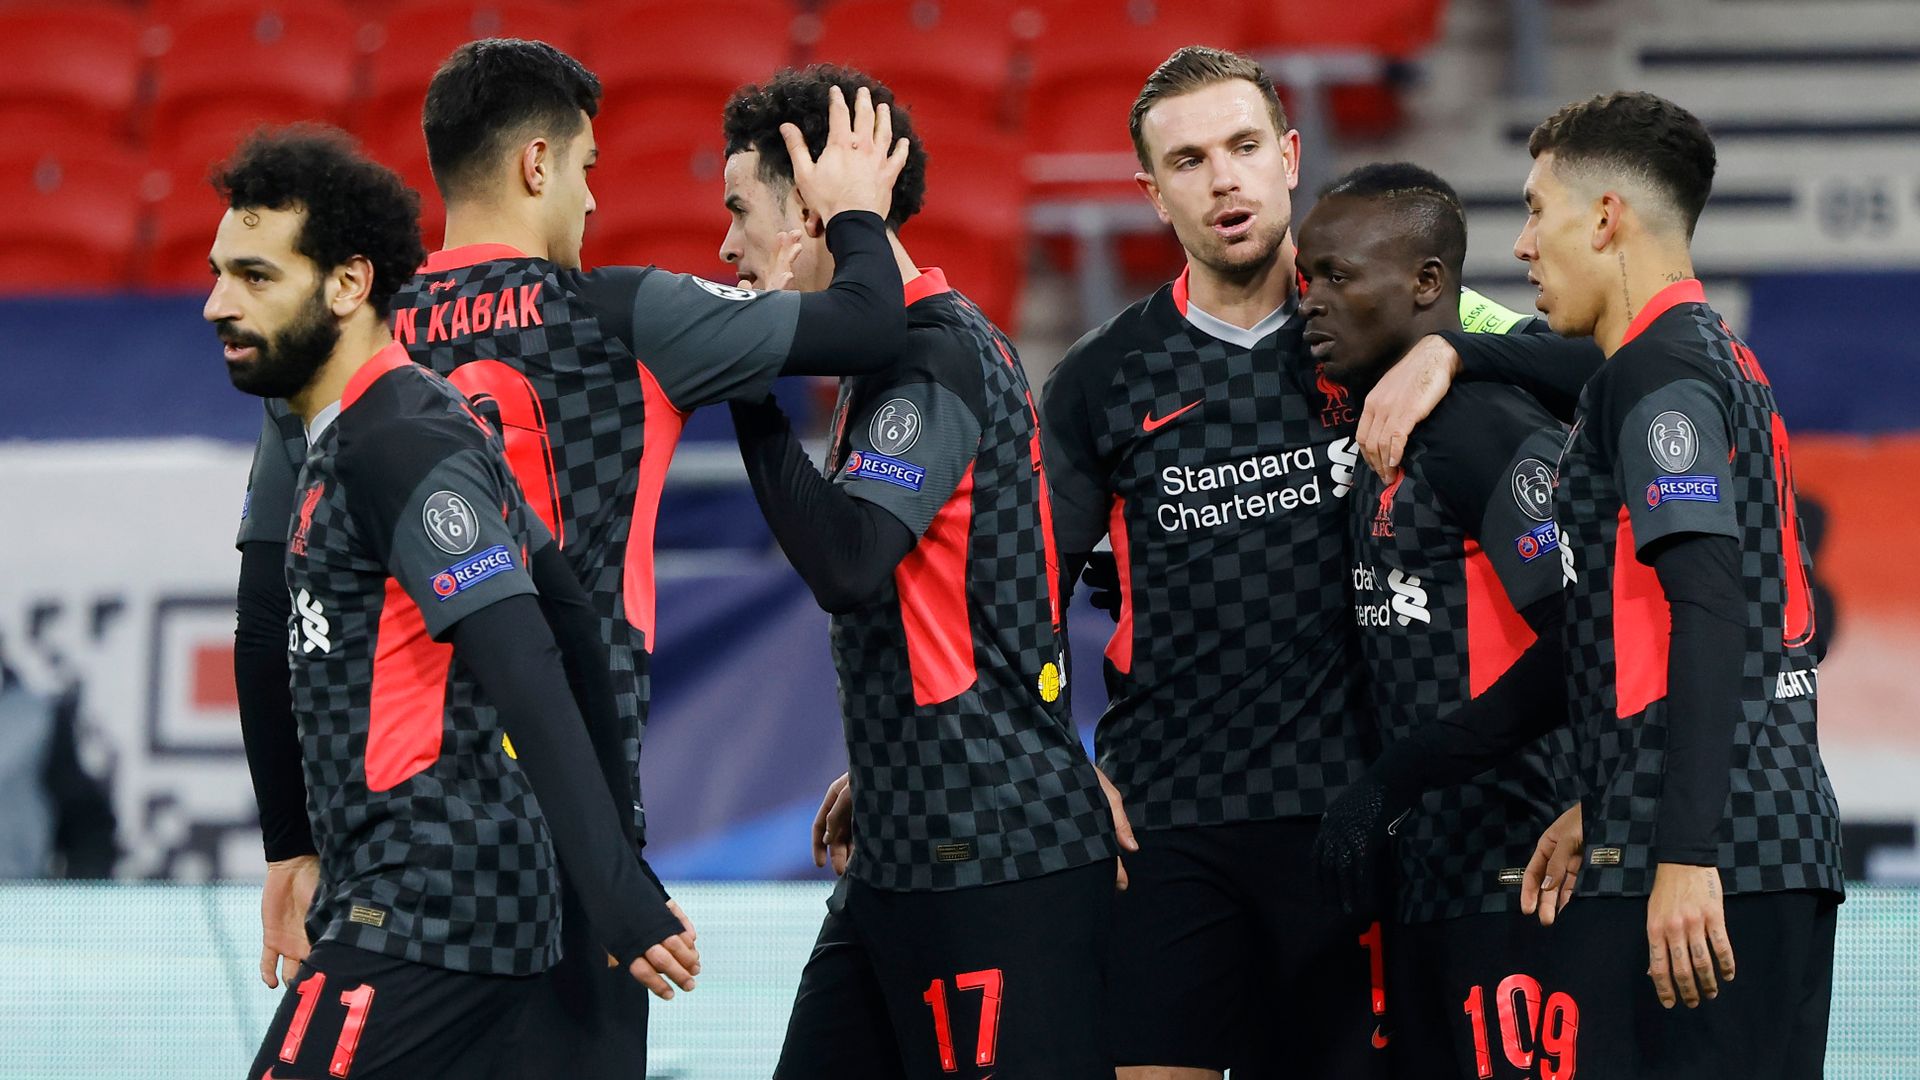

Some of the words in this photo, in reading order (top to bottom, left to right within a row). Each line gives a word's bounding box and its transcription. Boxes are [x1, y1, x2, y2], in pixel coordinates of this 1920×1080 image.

[426, 282, 544, 343] KABAK
[1462, 304, 1487, 330] CISM
[1481, 315, 1501, 333] ECT
[887, 425, 899, 440] 6
[1669, 440, 1682, 456] 6
[862, 459, 924, 484] RESPECT
[1162, 447, 1315, 496] Standard
[1535, 488, 1547, 504] 6
[1659, 481, 1718, 496] RESPECT
[1157, 476, 1321, 532] Chartered
[449, 521, 462, 537] 6
[455, 551, 511, 584] RESPECT
[1355, 598, 1390, 626] tered
[279, 971, 376, 1079] 11
[923, 968, 1004, 1073] 17
[1464, 974, 1543, 1079] 10
[1540, 991, 1580, 1080] 9
